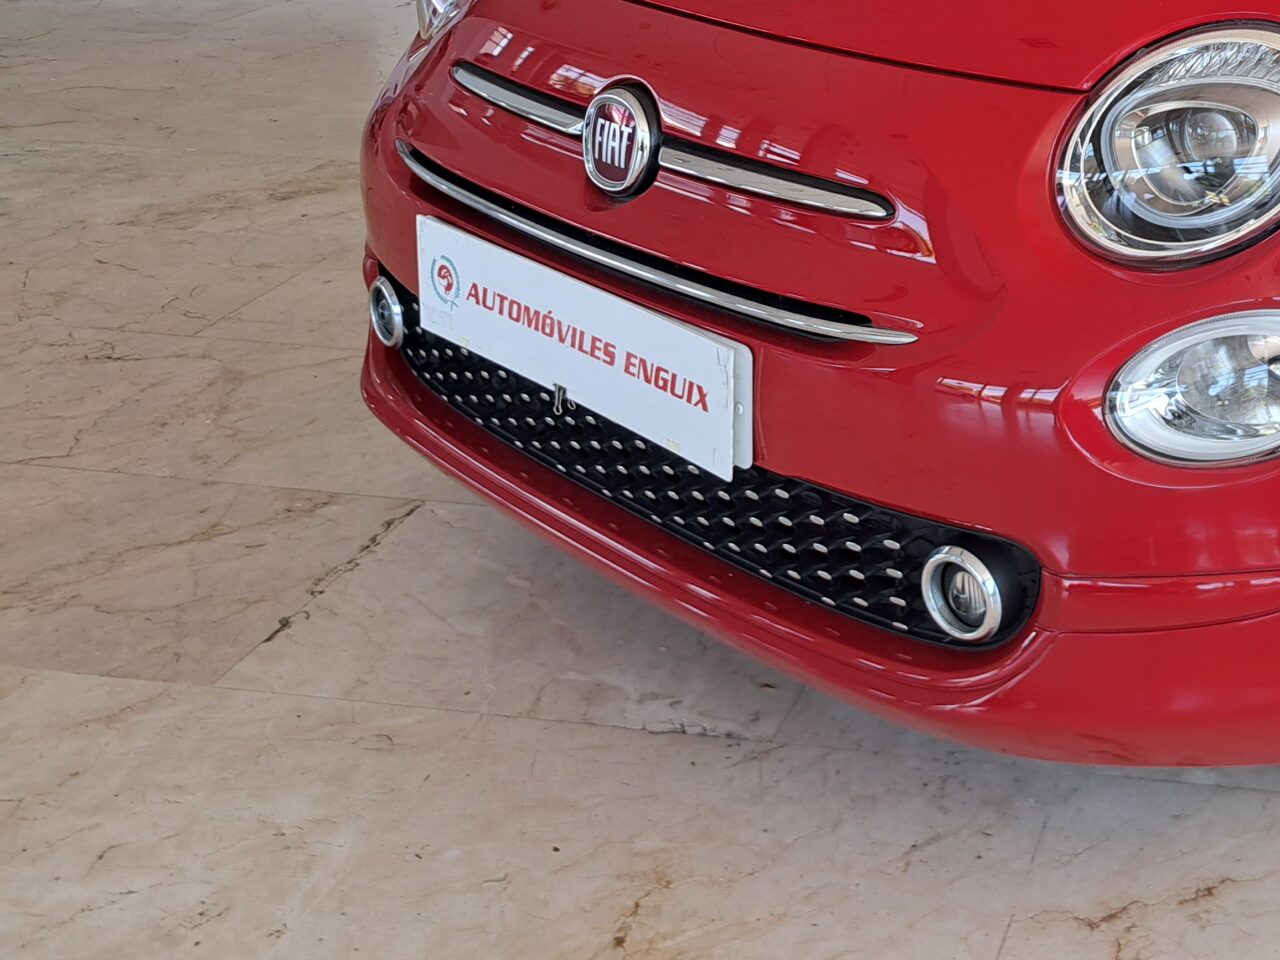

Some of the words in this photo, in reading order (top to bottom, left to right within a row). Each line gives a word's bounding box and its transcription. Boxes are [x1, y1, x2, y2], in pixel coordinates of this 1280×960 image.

[594, 117, 633, 169] FIAT
[466, 282, 616, 366] AUTOMÓVILES
[624, 351, 709, 413] ENGUIX
